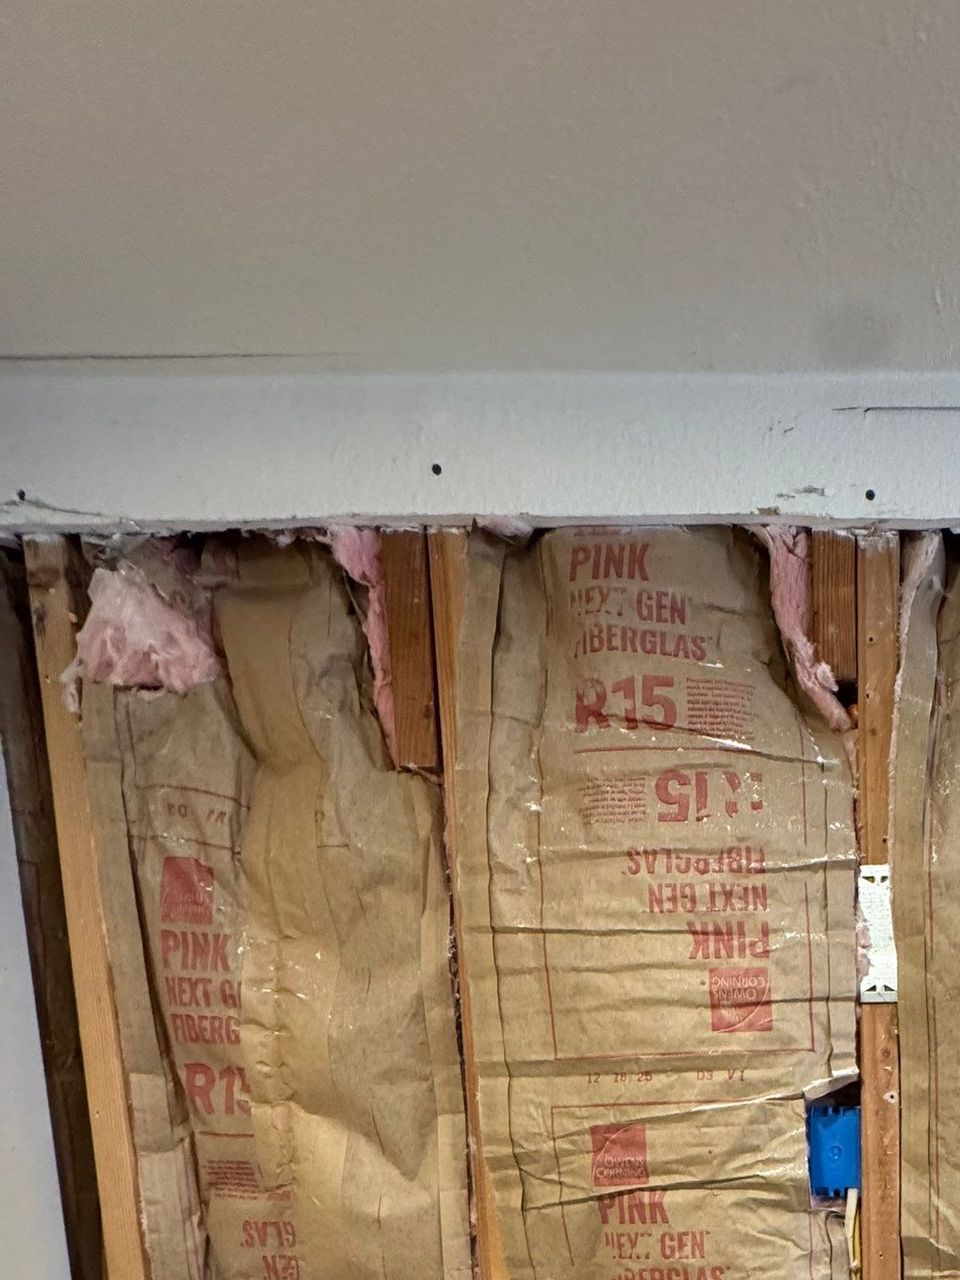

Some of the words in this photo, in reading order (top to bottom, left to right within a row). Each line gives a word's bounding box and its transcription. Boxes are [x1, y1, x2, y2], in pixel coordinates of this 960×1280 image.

[570, 543, 650, 581] PINK
[636, 589, 686, 625] GEN
[575, 674, 677, 734] R15
[627, 845, 766, 876] FIBERGLAS
[646, 882, 697, 914] GEN
[709, 882, 768, 912] NEXT
[160, 929, 231, 972] PINK
[686, 920, 770, 960] PINK
[165, 976, 213, 1009] NEXT
[597, 1190, 669, 1225] PINK
[660, 1230, 706, 1260] GEN
